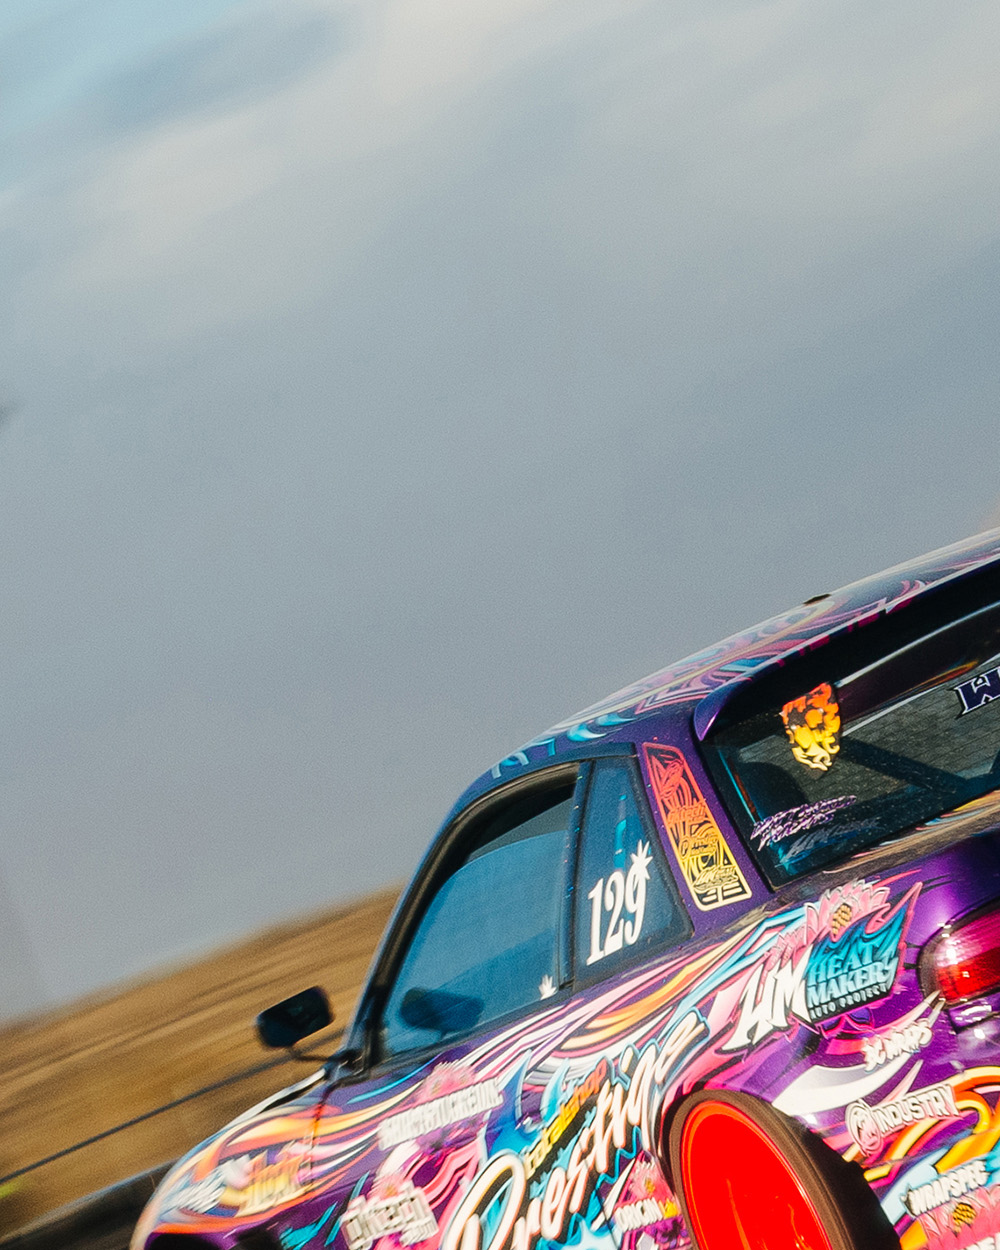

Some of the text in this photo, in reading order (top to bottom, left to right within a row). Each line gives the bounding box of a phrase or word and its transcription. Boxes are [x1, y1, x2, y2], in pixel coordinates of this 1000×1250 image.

[587, 861, 648, 965] 129
[808, 941, 877, 985] HEAT
[840, 982, 887, 1007] PROJECT
[873, 1083, 960, 1136] INDUSTRY
